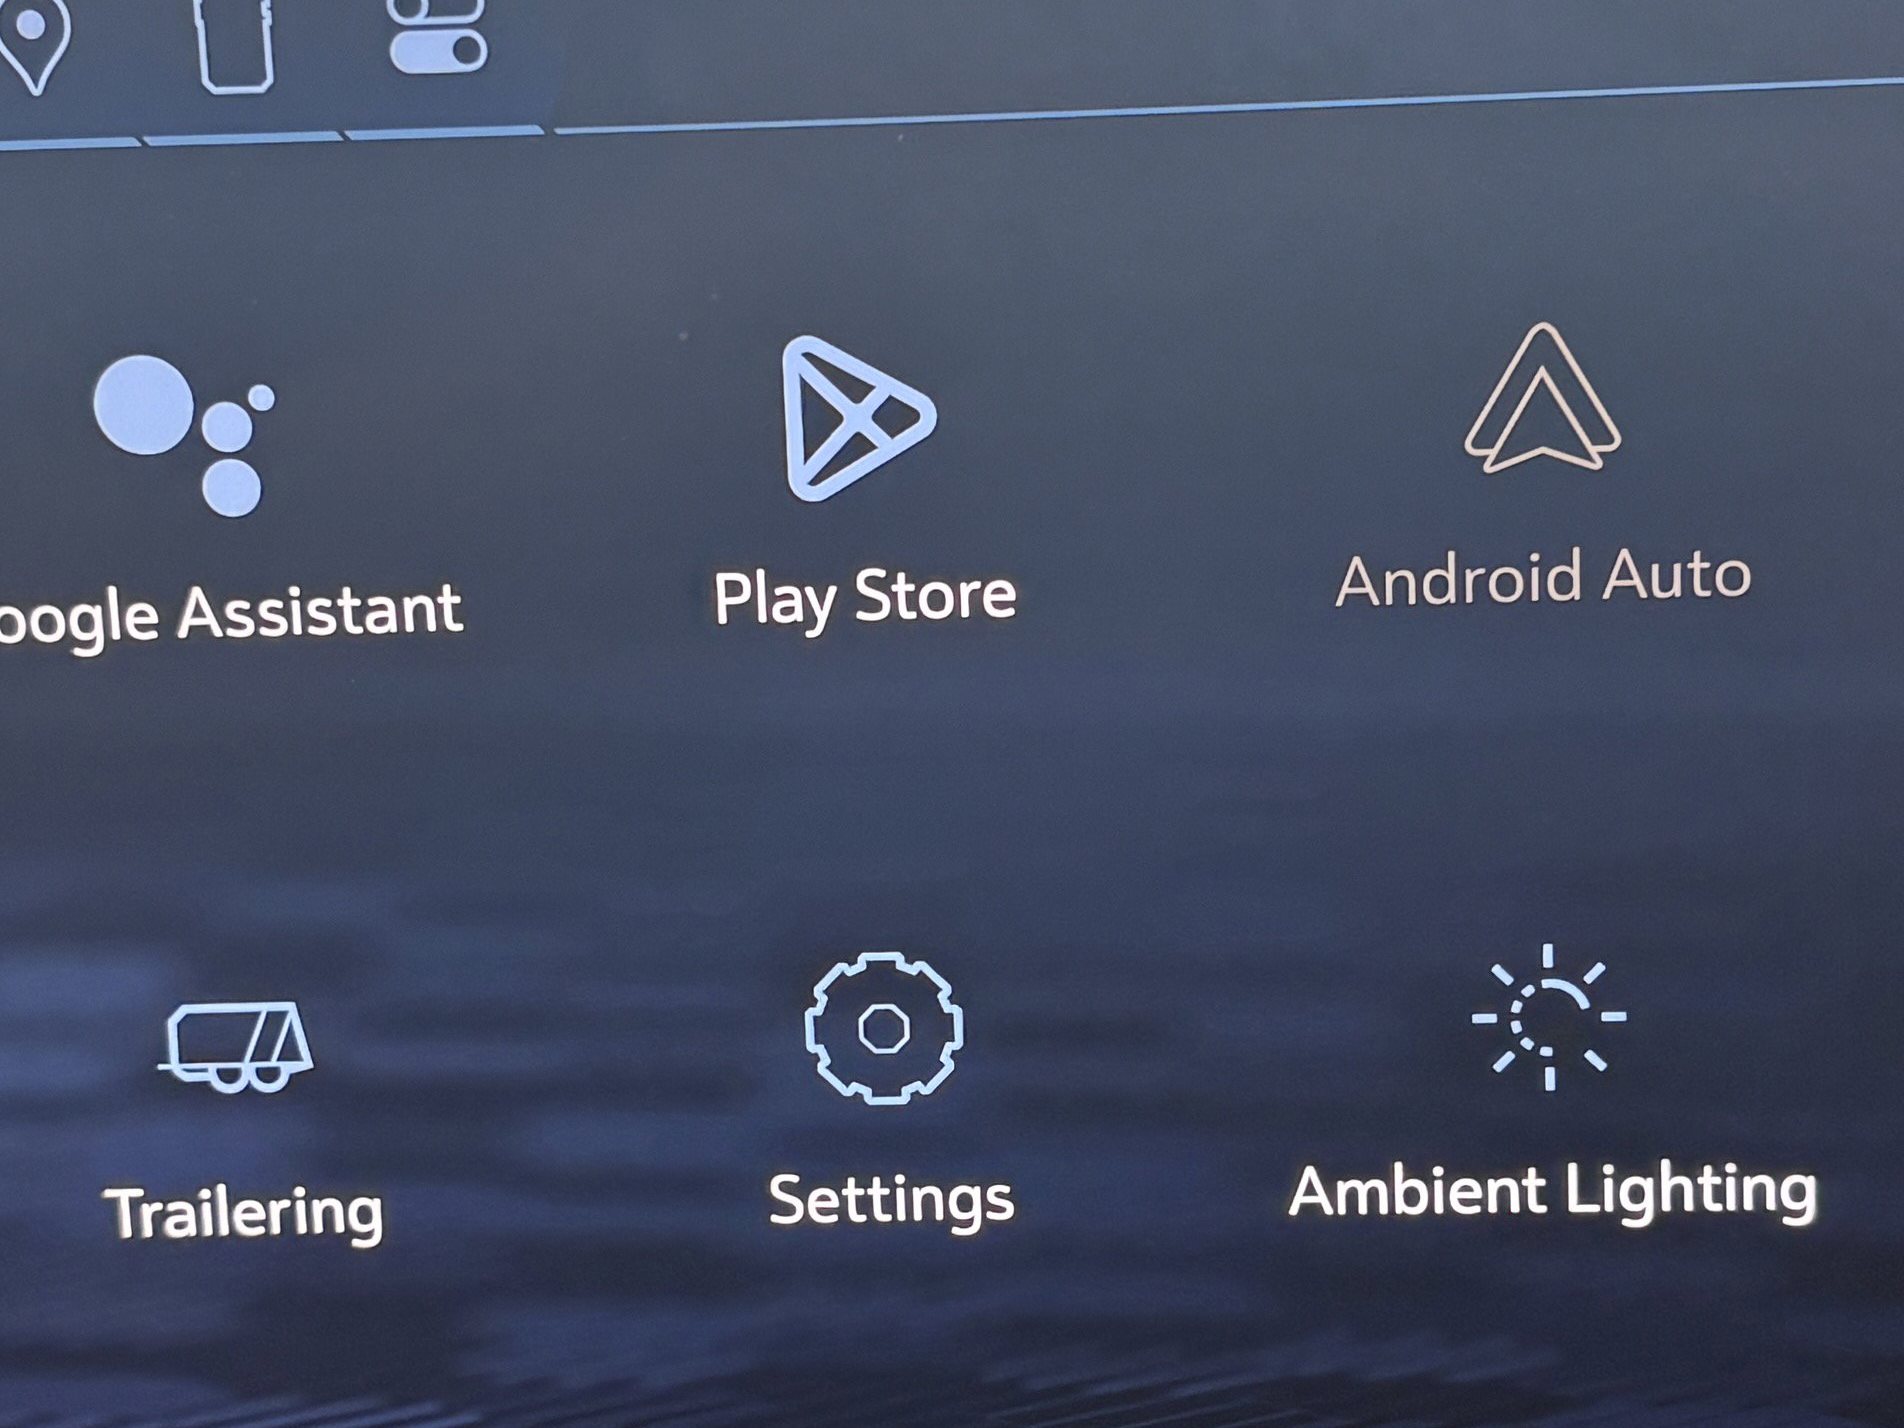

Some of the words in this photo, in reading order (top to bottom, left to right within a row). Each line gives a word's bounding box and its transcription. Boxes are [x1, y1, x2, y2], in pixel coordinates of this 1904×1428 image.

[716, 569, 838, 638] Play
[856, 568, 1016, 621] Store
[1336, 547, 1580, 606] Android
[1603, 548, 1750, 599] Auto
[178, 584, 463, 638] Assistant
[103, 1184, 382, 1248] Trailering
[771, 1174, 1014, 1235] Settings
[1289, 1162, 1547, 1215] Ambient
[1568, 1159, 1816, 1228] Lighting
